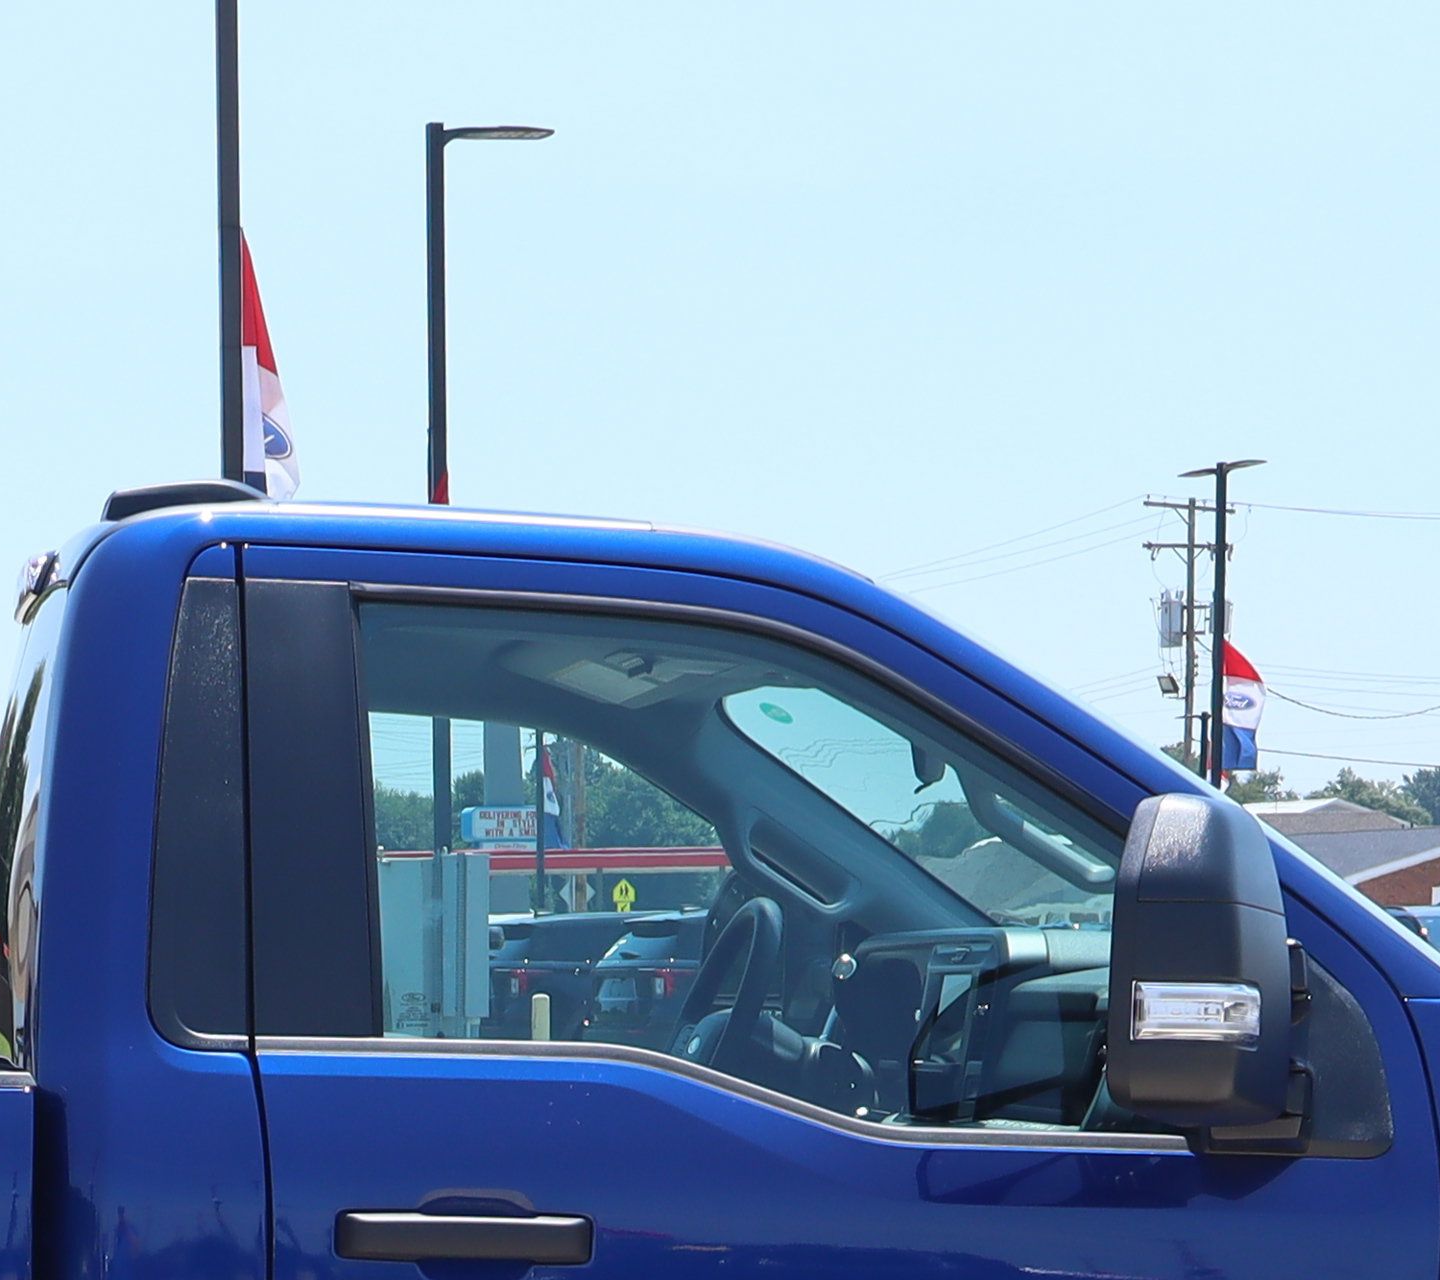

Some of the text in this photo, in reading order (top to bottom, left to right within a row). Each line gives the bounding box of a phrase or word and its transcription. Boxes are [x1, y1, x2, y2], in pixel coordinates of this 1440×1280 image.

[497, 820, 505, 828] IN
[485, 828, 537, 837] WITH A SMIL
